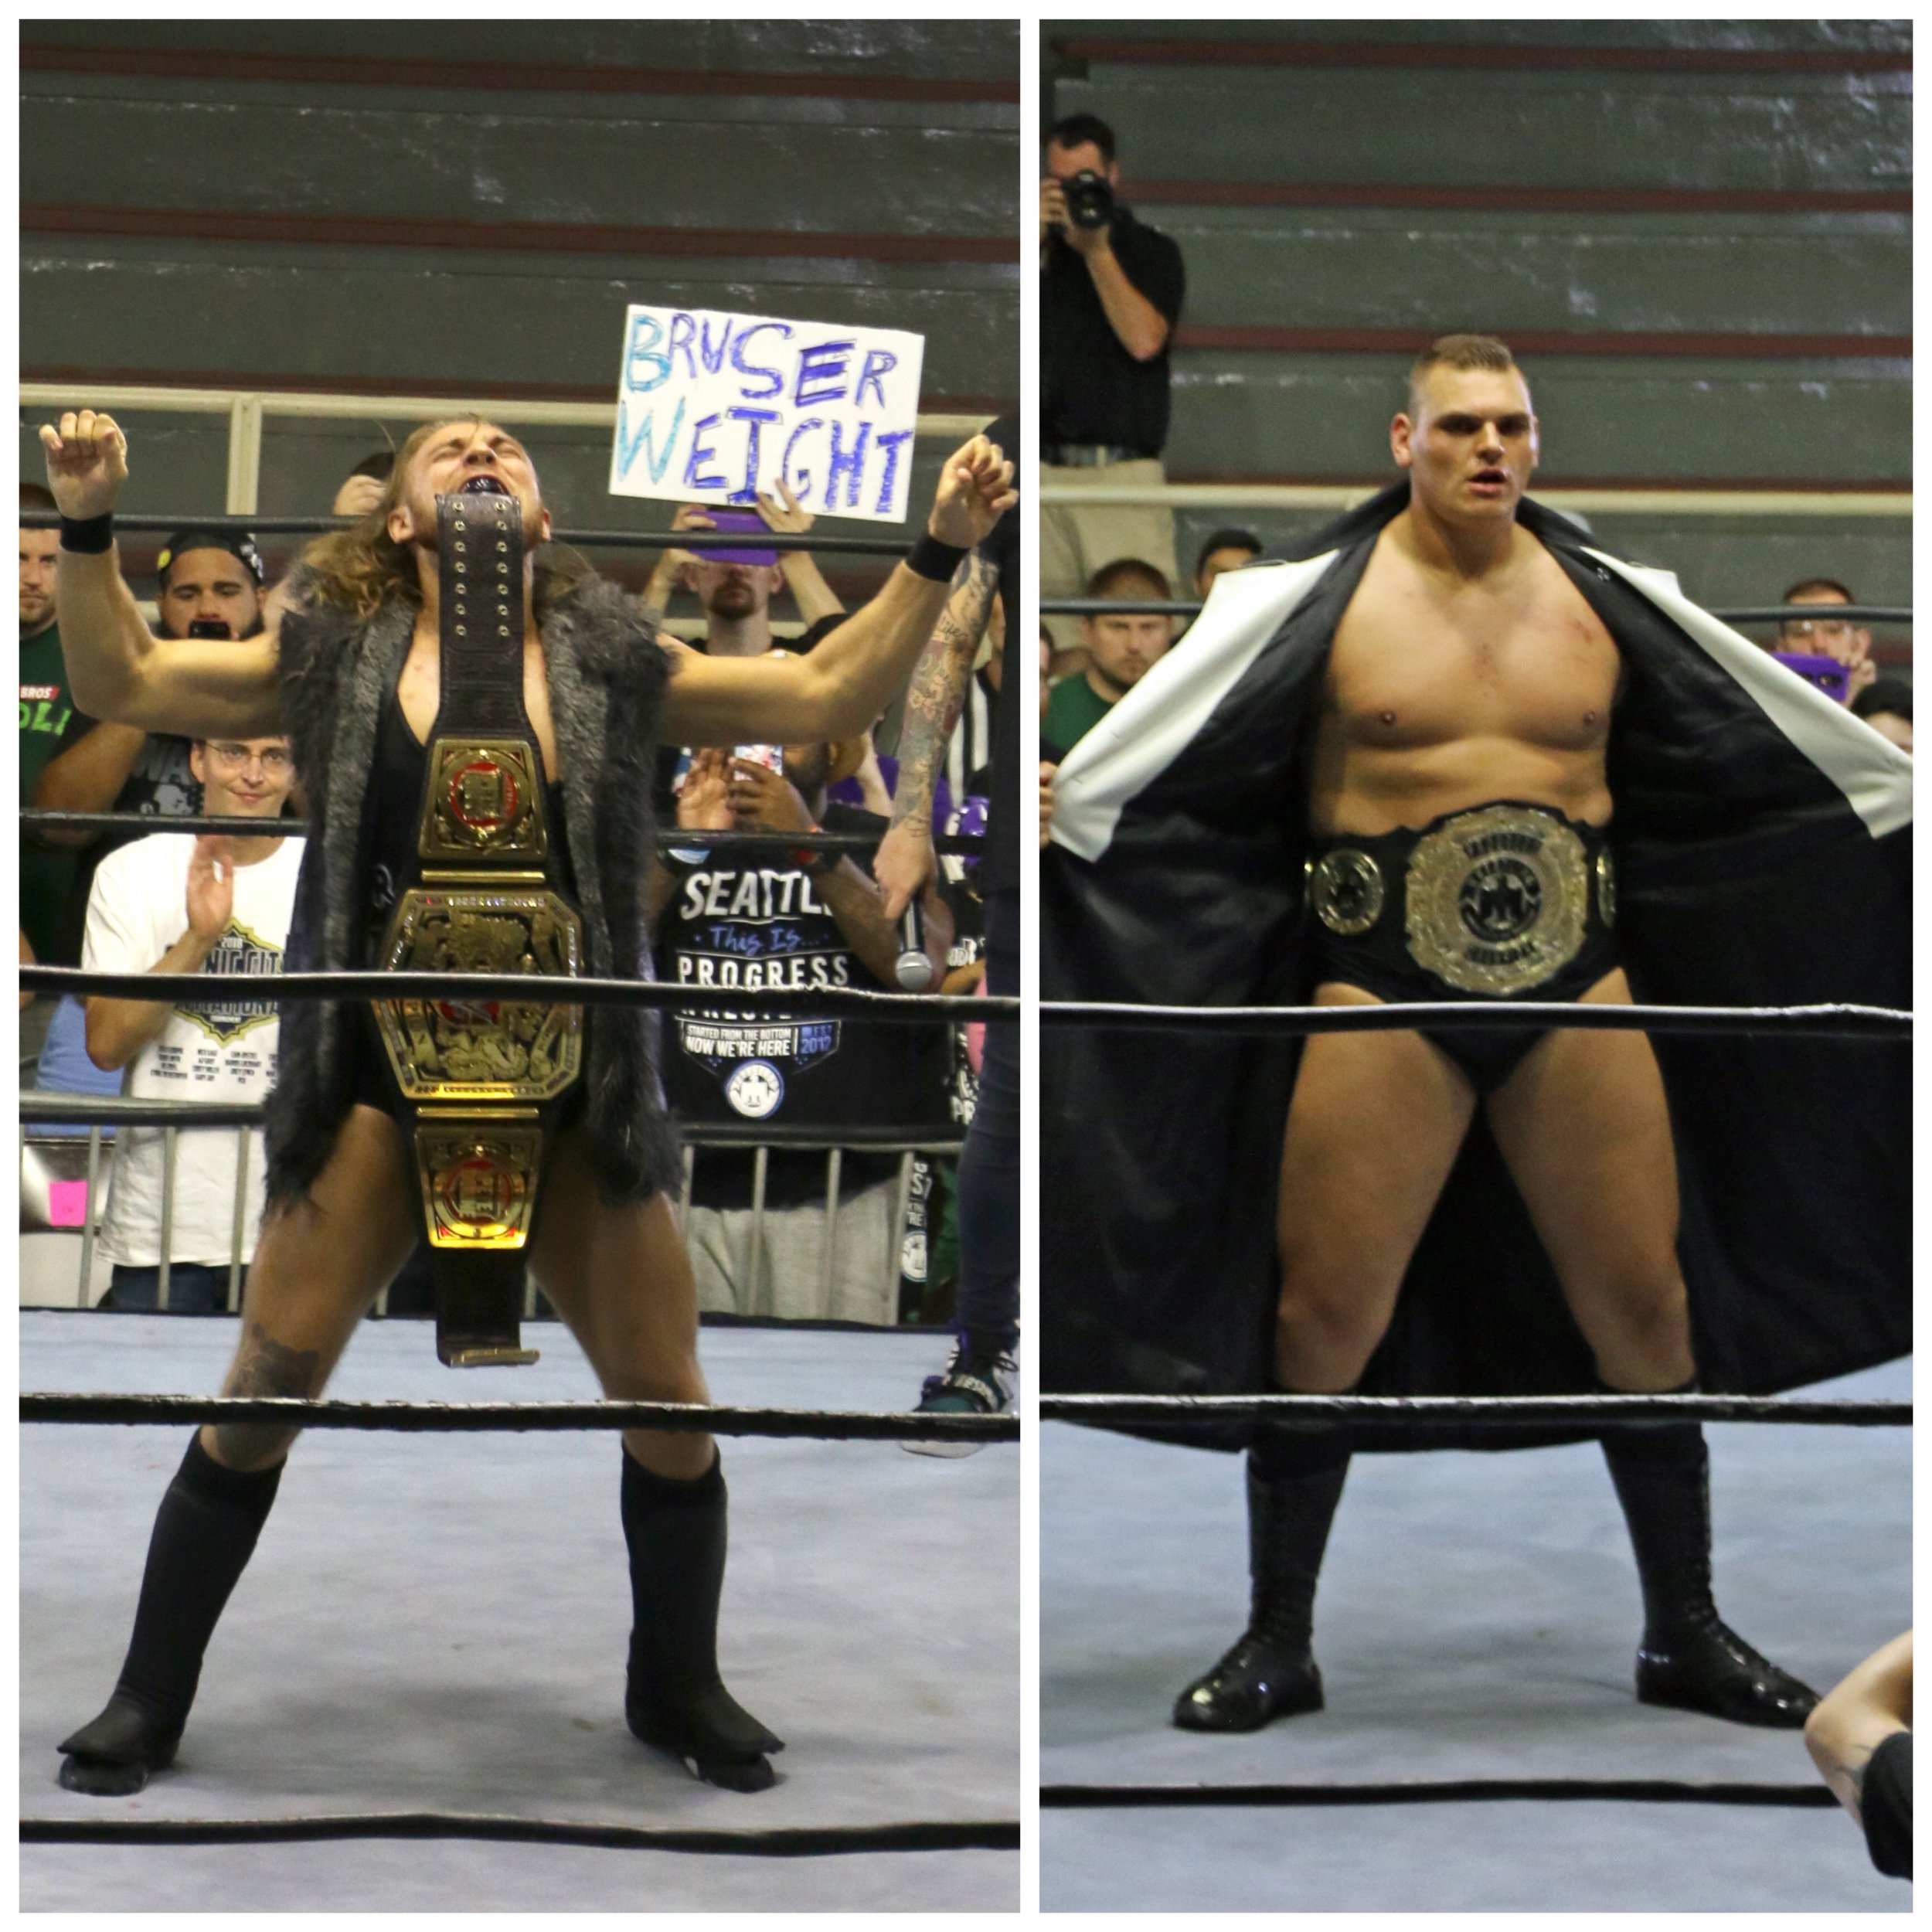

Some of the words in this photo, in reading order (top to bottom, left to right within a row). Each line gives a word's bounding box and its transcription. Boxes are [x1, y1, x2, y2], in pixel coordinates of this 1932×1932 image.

[617, 396, 914, 514] WEIGHT
[679, 869, 833, 921] SEATTL
[709, 927, 762, 956] This
[678, 955, 849, 988] PROGRESS
[685, 1036, 716, 1056] NOW
[716, 1040, 756, 1058] WE'RE
[757, 1040, 791, 1056] HERE
[687, 1026, 719, 1039] STARTED
[720, 1027, 743, 1040] FROM
[744, 1029, 760, 1040] THE
[760, 1027, 792, 1040] BOTTOM
